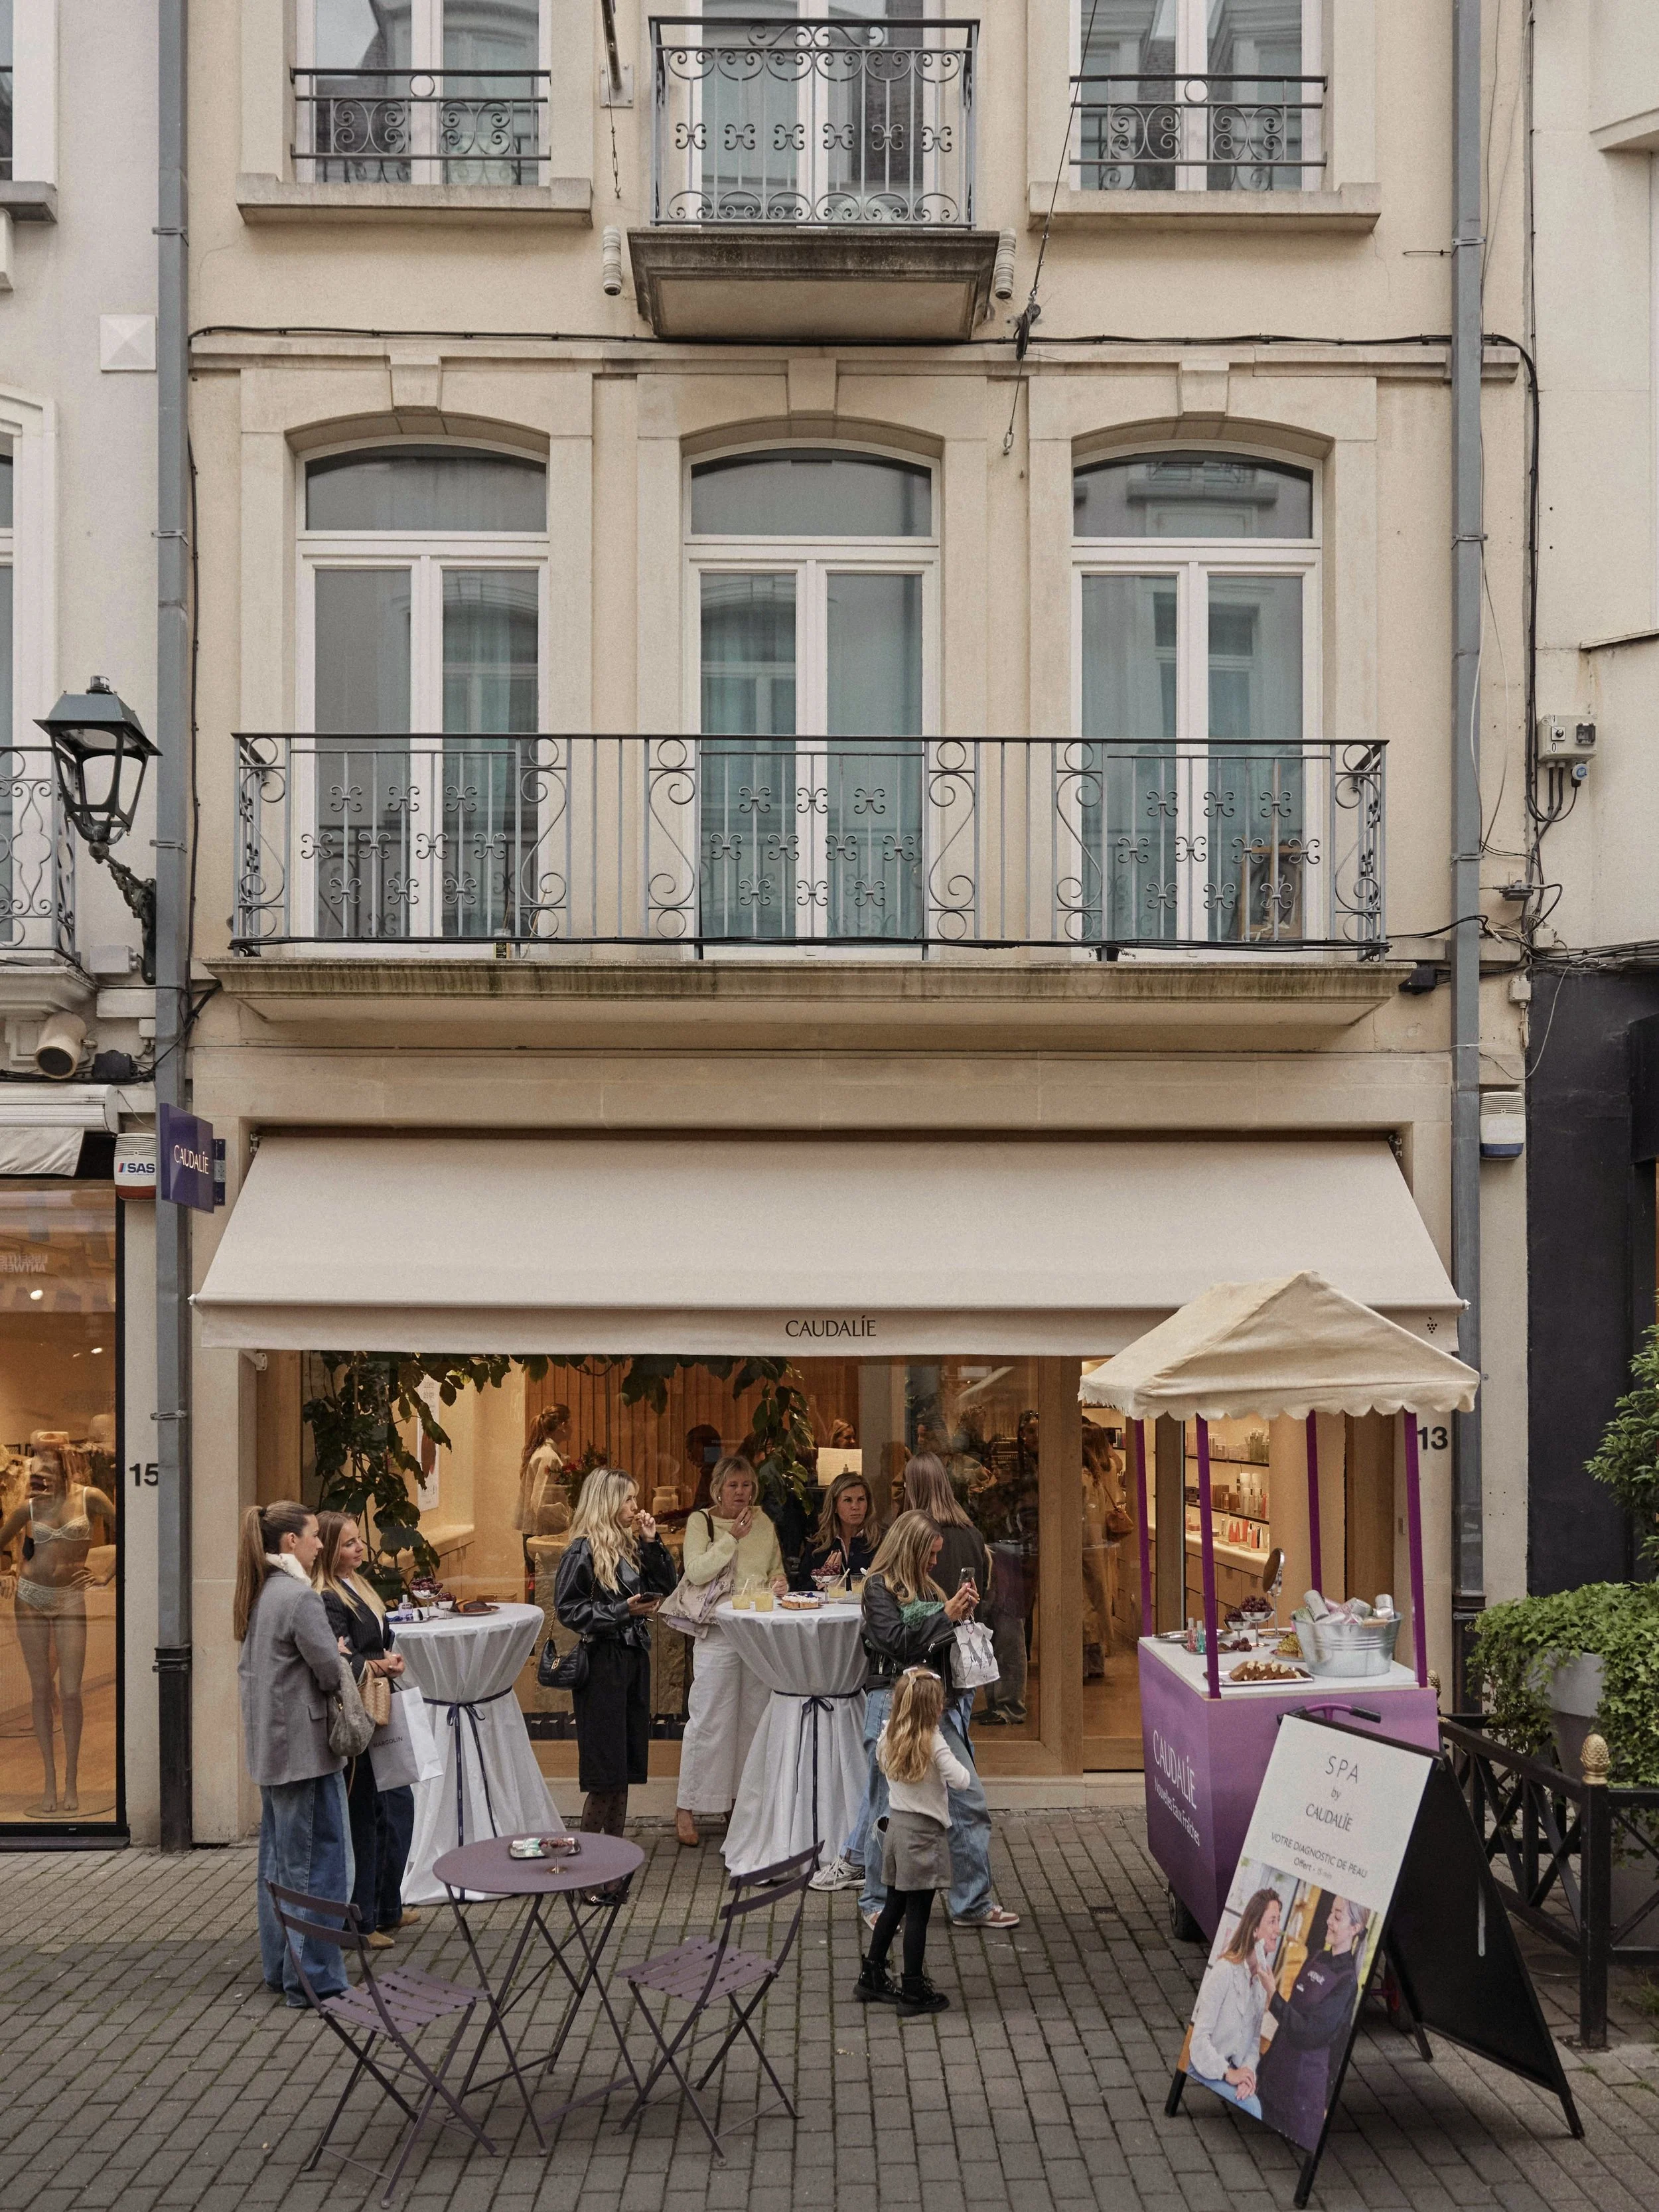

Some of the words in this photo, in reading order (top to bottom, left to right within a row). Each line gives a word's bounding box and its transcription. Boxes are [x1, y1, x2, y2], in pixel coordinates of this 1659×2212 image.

[127, 1163, 155, 1173] SAS
[1417, 1426, 1448, 1450] 13
[129, 1463, 159, 1487] 15
[1325, 1755, 1358, 1784] SPA
[1331, 1787, 1342, 1801] by
[1172, 1797, 1183, 1825] Eaux
[1271, 1832, 1293, 1848] VOTRE
[1293, 1842, 1336, 1866] DIAGNOSTIC
[1336, 1859, 1347, 1870] DE
[1348, 1864, 1368, 1878] PEAU
[1294, 1857, 1311, 1872] Offert
